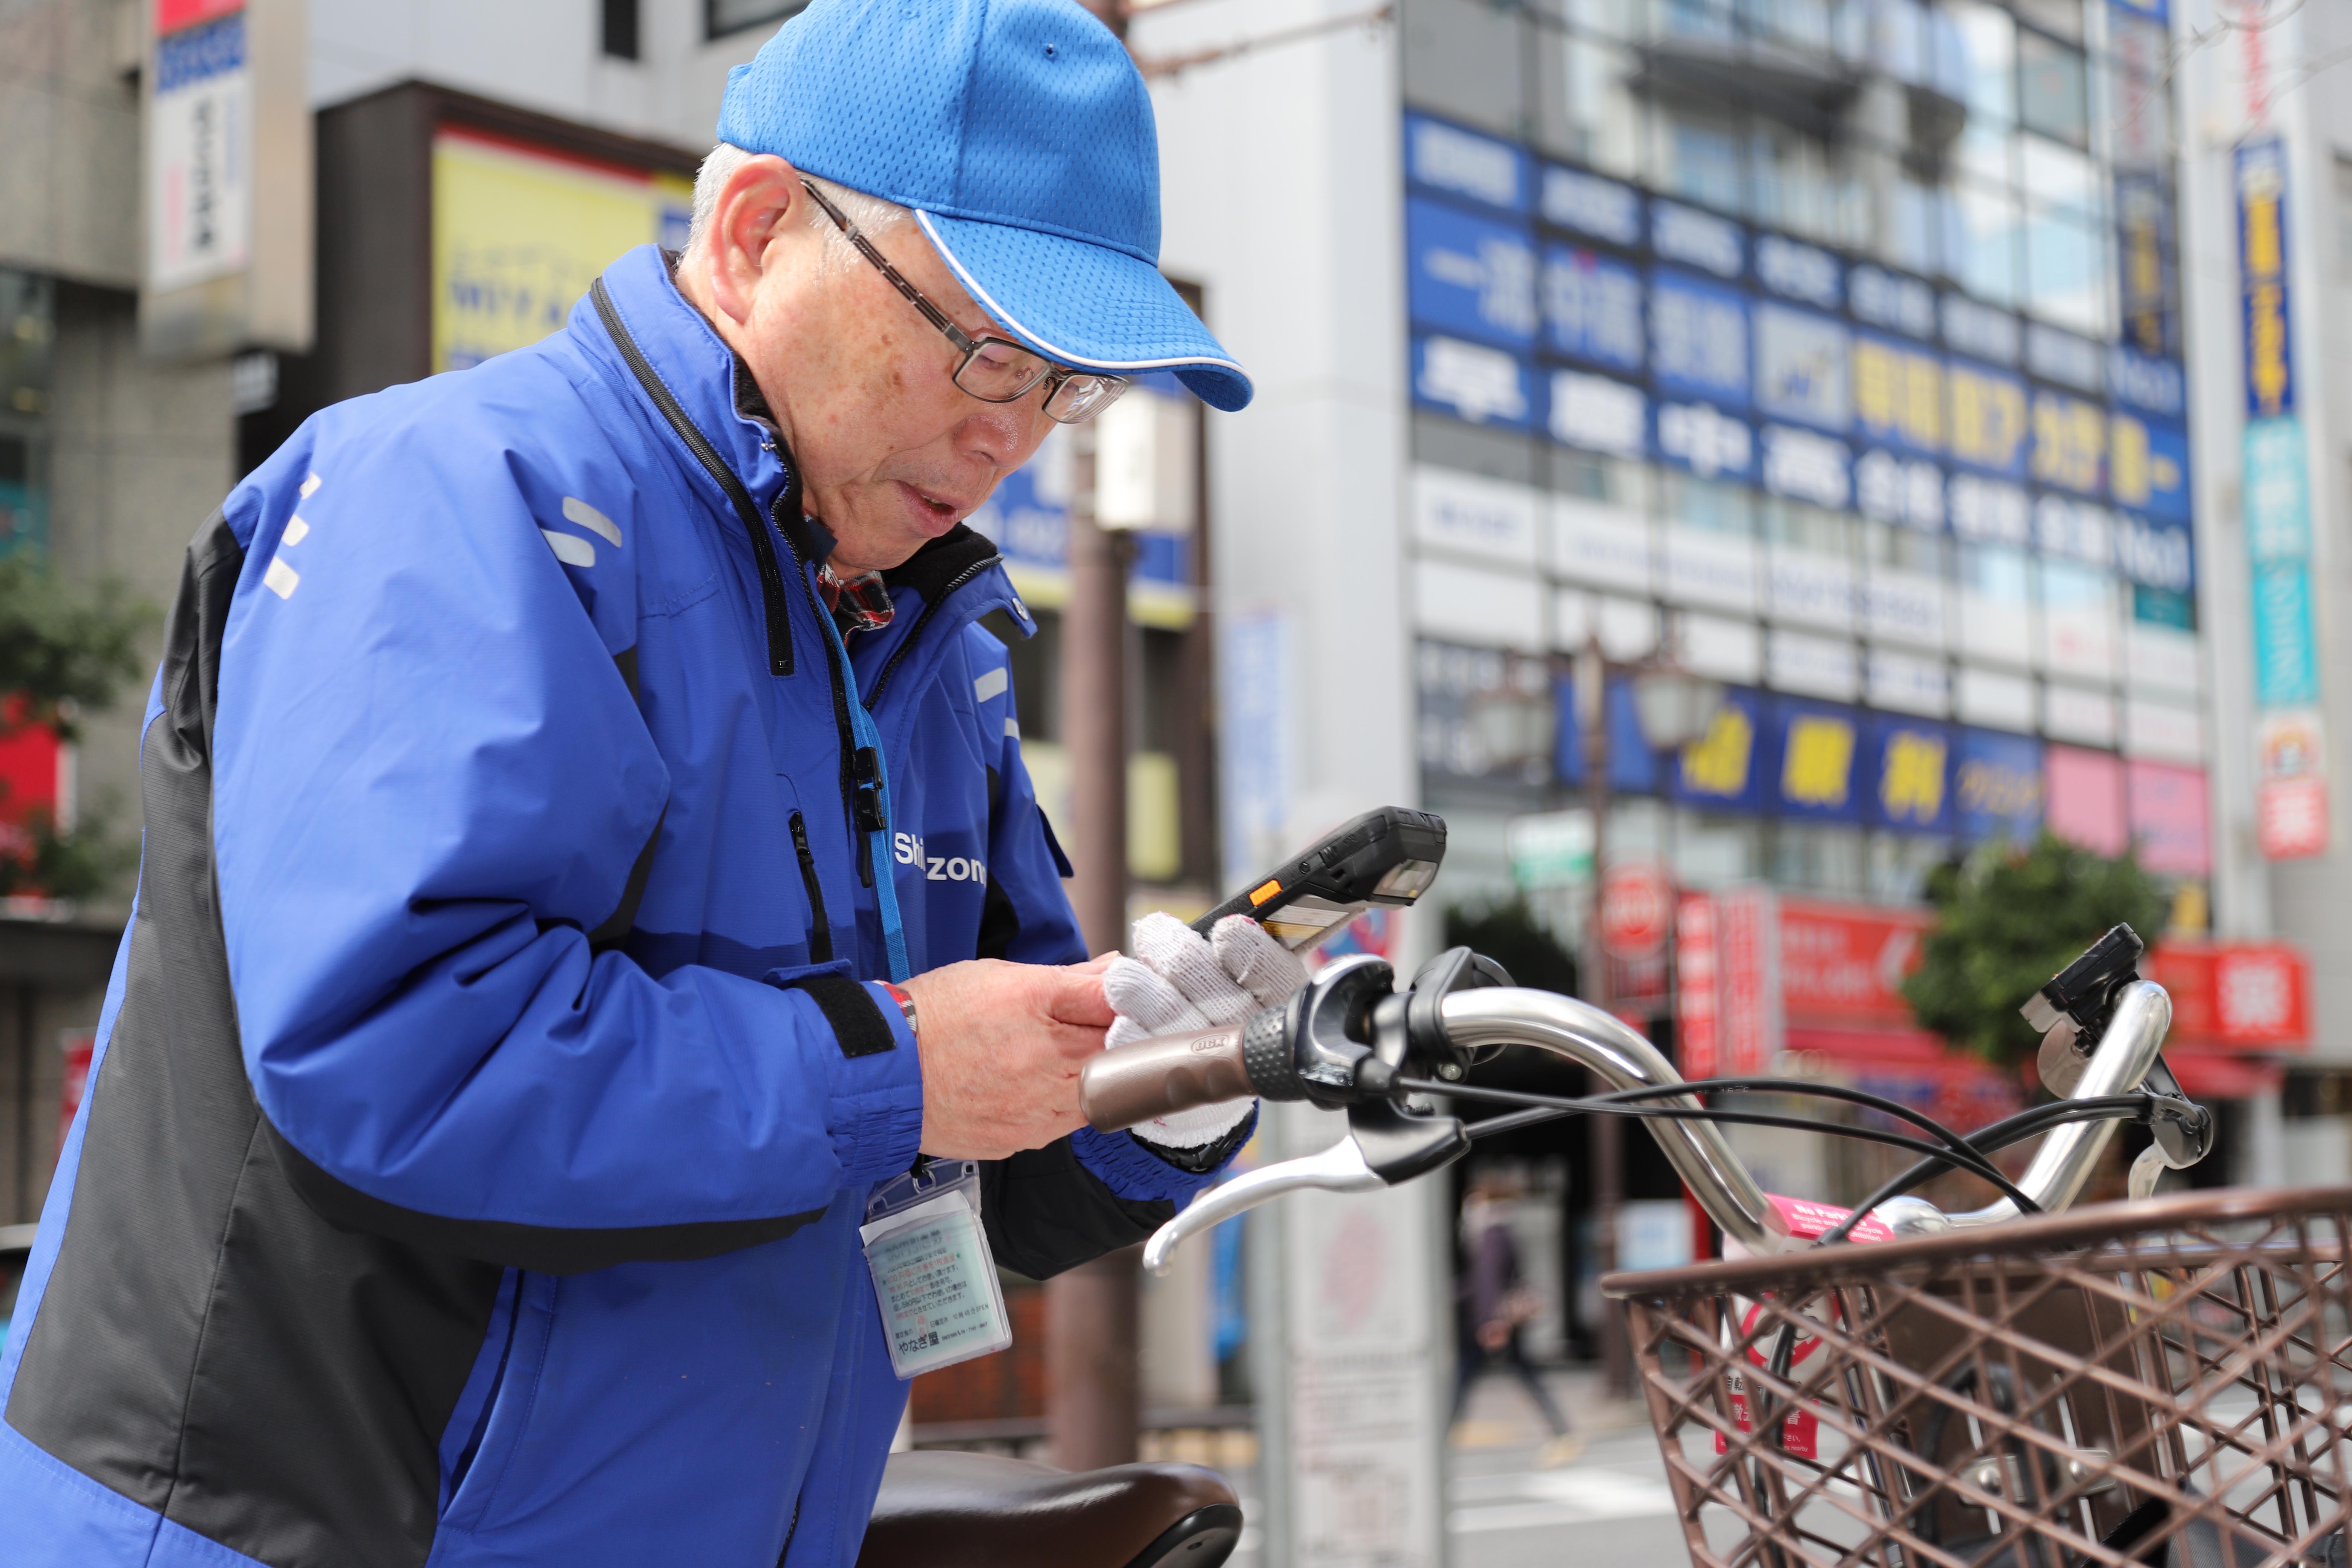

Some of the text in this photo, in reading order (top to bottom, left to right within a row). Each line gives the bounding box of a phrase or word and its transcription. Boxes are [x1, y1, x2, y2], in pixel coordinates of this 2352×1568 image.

[1195, 1036, 1227, 1052] OGK
[1792, 1213, 1822, 1225] Bicycle
[1824, 1219, 1839, 1227] and
[898, 1332, 940, 1355] やなぎ屋
